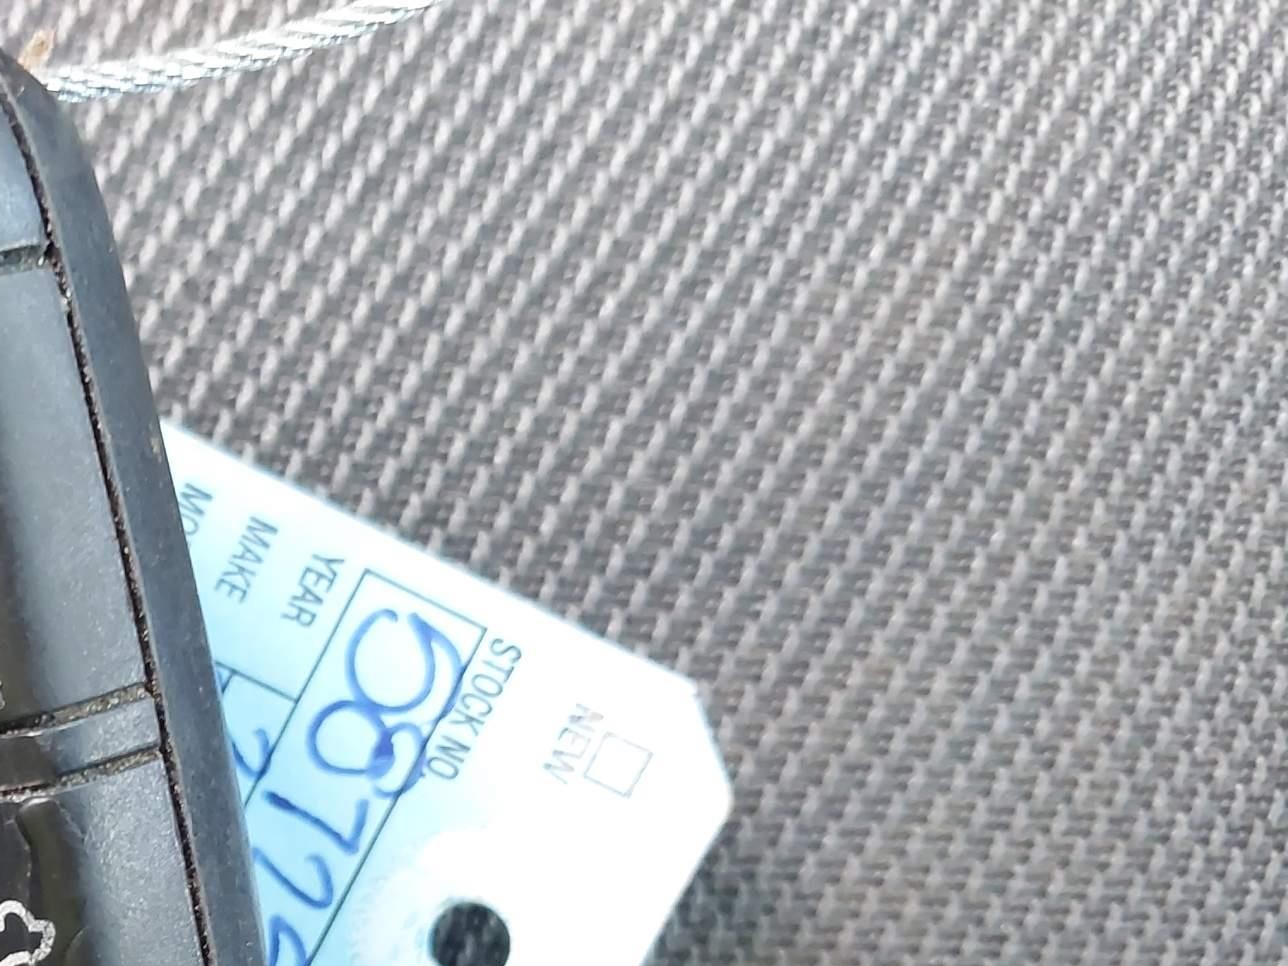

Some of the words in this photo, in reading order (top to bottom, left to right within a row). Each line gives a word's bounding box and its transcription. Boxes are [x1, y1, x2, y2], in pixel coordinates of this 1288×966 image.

[214, 516, 278, 604] MAKE
[281, 553, 345, 628] YEAR
[449, 637, 523, 737] STOCK
[542, 703, 604, 785] NEW
